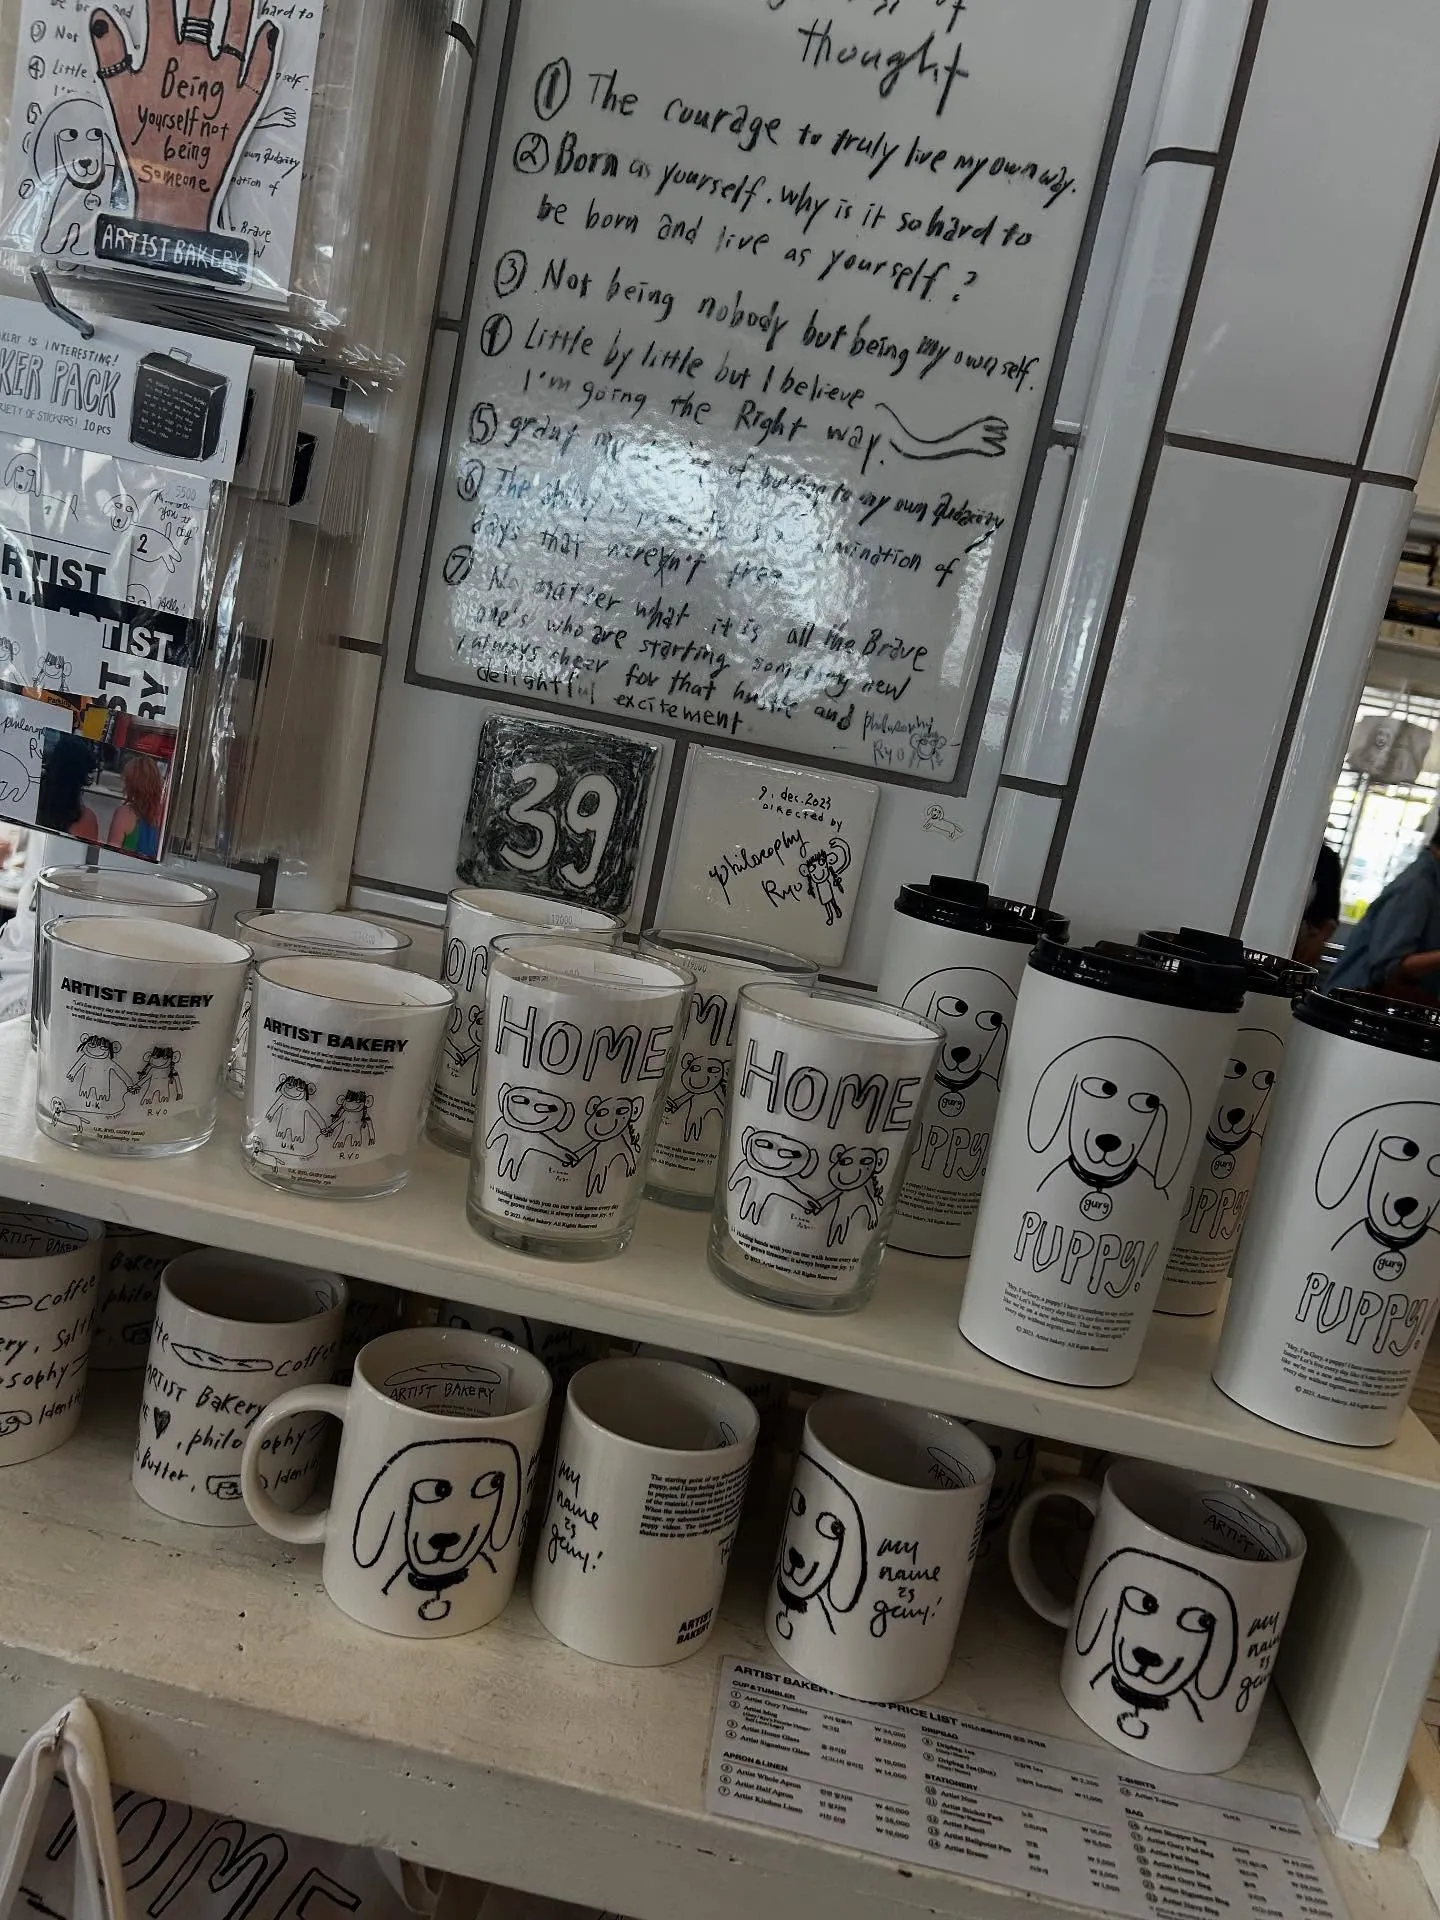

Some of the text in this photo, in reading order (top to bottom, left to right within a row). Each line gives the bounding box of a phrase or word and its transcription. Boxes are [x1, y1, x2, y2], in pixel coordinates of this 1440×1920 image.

[52, 60, 88, 79] Little
[161, 57, 225, 119] Being
[798, 18, 969, 116] thought
[131, 104, 230, 146] yourself not
[163, 136, 212, 170] being
[589, 70, 638, 116] The
[664, 100, 781, 151] courage
[798, 125, 823, 146] to
[831, 130, 899, 180] truly
[905, 137, 947, 172] live
[555, 132, 618, 178] Born
[780, 182, 833, 235] why
[927, 205, 996, 249] hard
[1002, 226, 1033, 248] to
[102, 223, 245, 271] ARTIST BAKERY
[537, 195, 811, 267] be born and live as
[542, 257, 592, 298] Not
[606, 266, 674, 323] being
[698, 289, 787, 350] nobody
[803, 309, 847, 353] but
[850, 316, 909, 376] being
[917, 335, 949, 378] my
[50, 360, 121, 418] PACK
[524, 317, 594, 356] Little
[603, 328, 634, 380] by
[641, 340, 704, 378] little
[714, 351, 752, 390] but
[779, 367, 864, 408] believe
[577, 380, 648, 420] going
[671, 391, 712, 425] the
[734, 399, 807, 446] Right
[547, 614, 584, 639] who
[591, 624, 628, 650] are
[636, 596, 690, 631] what
[786, 620, 816, 649] all
[863, 628, 929, 672] Brave
[625, 663, 660, 688] for
[667, 673, 717, 701] that
[814, 703, 854, 731] and
[499, 762, 619, 889] 39
[61, 976, 215, 1008] ARTIST BAKERY
[263, 1016, 409, 1053] ARTIST BAKERY
[496, 995, 674, 1084] HOME
[740, 1039, 921, 1134] HOME
[389, 1382, 495, 1406] ARTIST BAKERY
[676, 1620, 712, 1645] BAKERY
[679, 1607, 714, 1633] ARTIST
[734, 1664, 782, 1682] ARTIST
[929, 1712, 959, 1726] LIST
